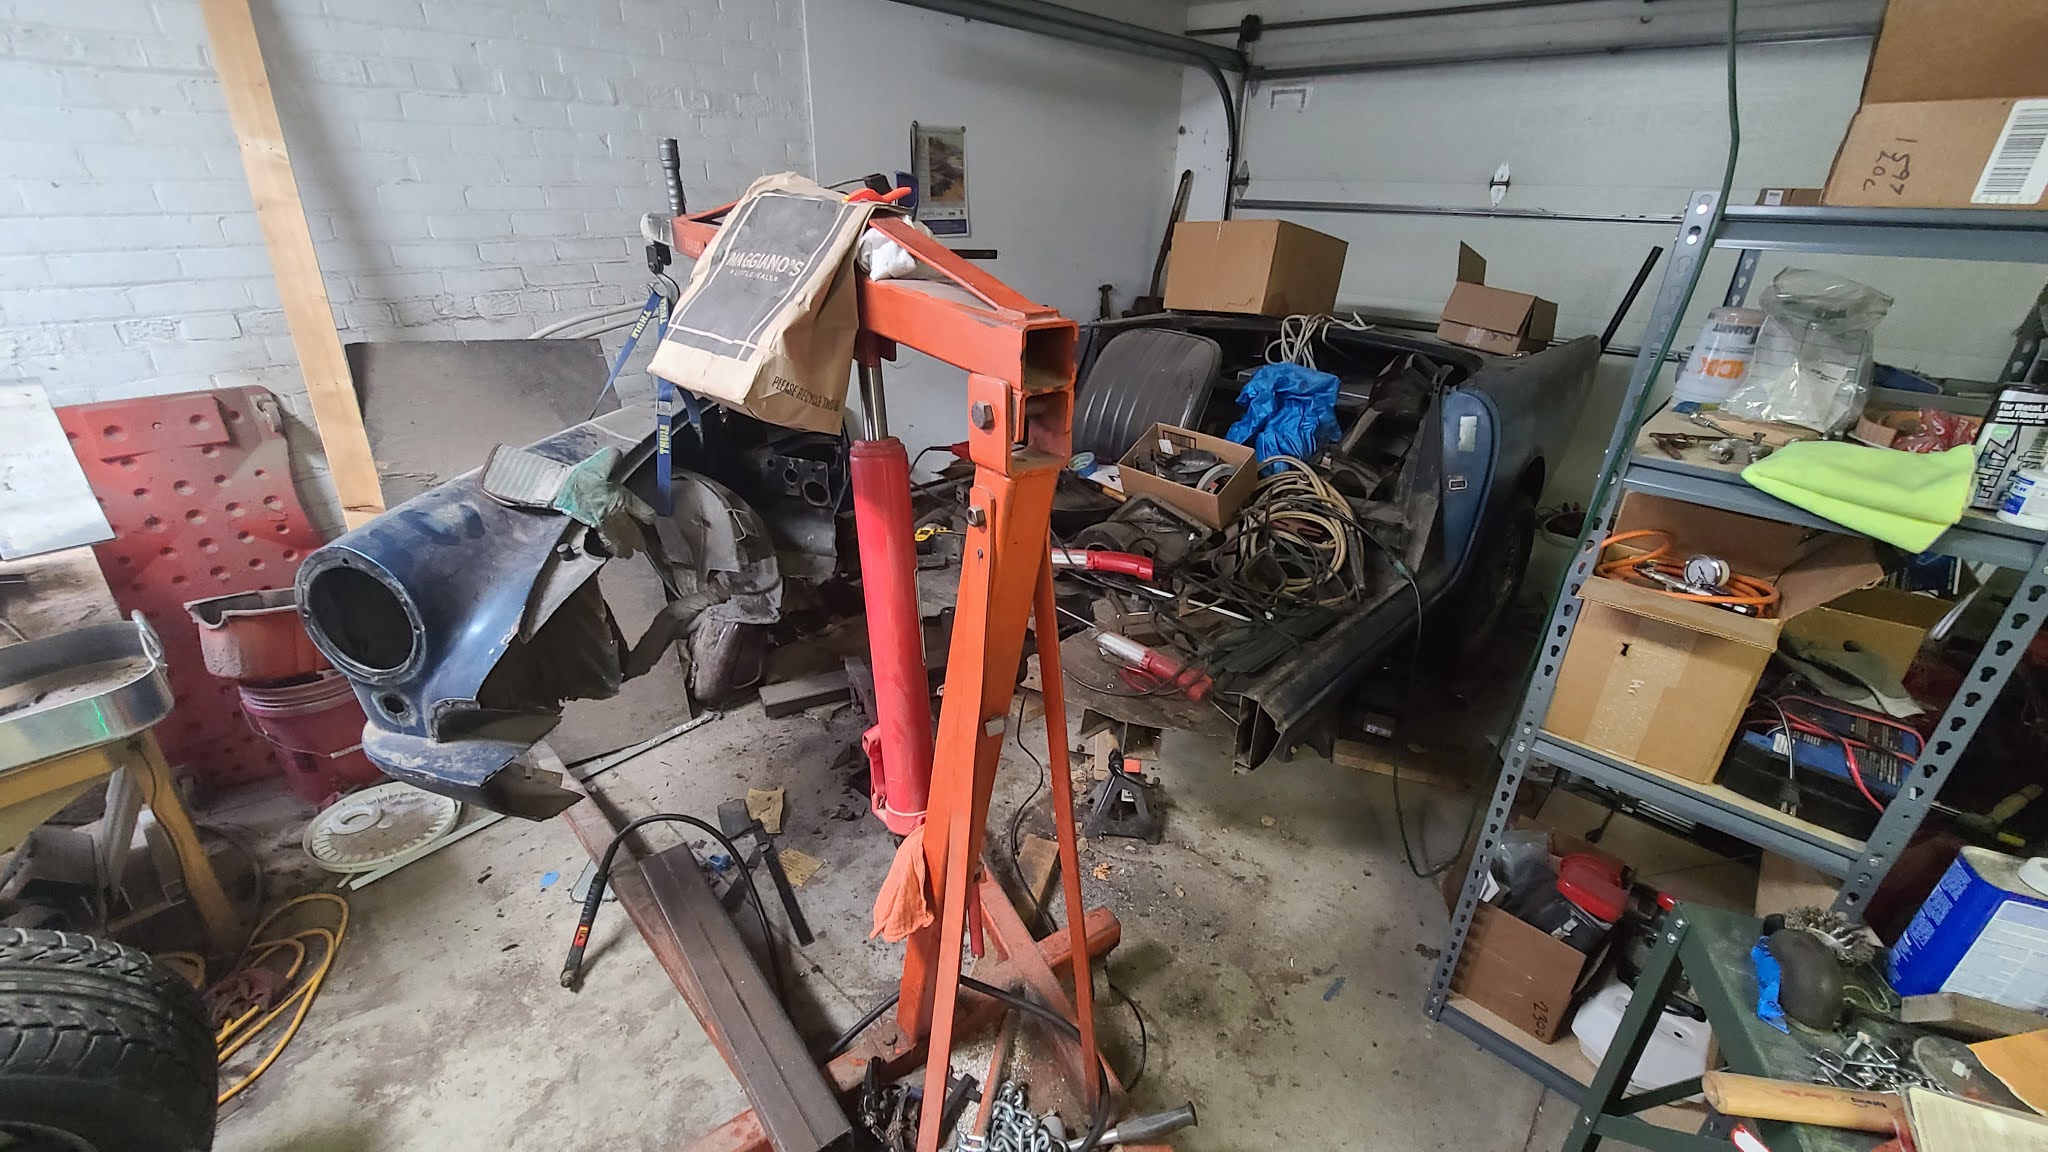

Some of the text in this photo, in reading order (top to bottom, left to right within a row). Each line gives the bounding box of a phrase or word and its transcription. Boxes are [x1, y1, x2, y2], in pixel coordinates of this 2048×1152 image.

[726, 252, 804, 277] MAGGIANO'S
[631, 310, 652, 339] THULE
[1712, 323, 1753, 335] QUART
[772, 376, 798, 397] PLEASE
[796, 388, 822, 408] RECYCLE
[1532, 1001, 1549, 1038] 2300
